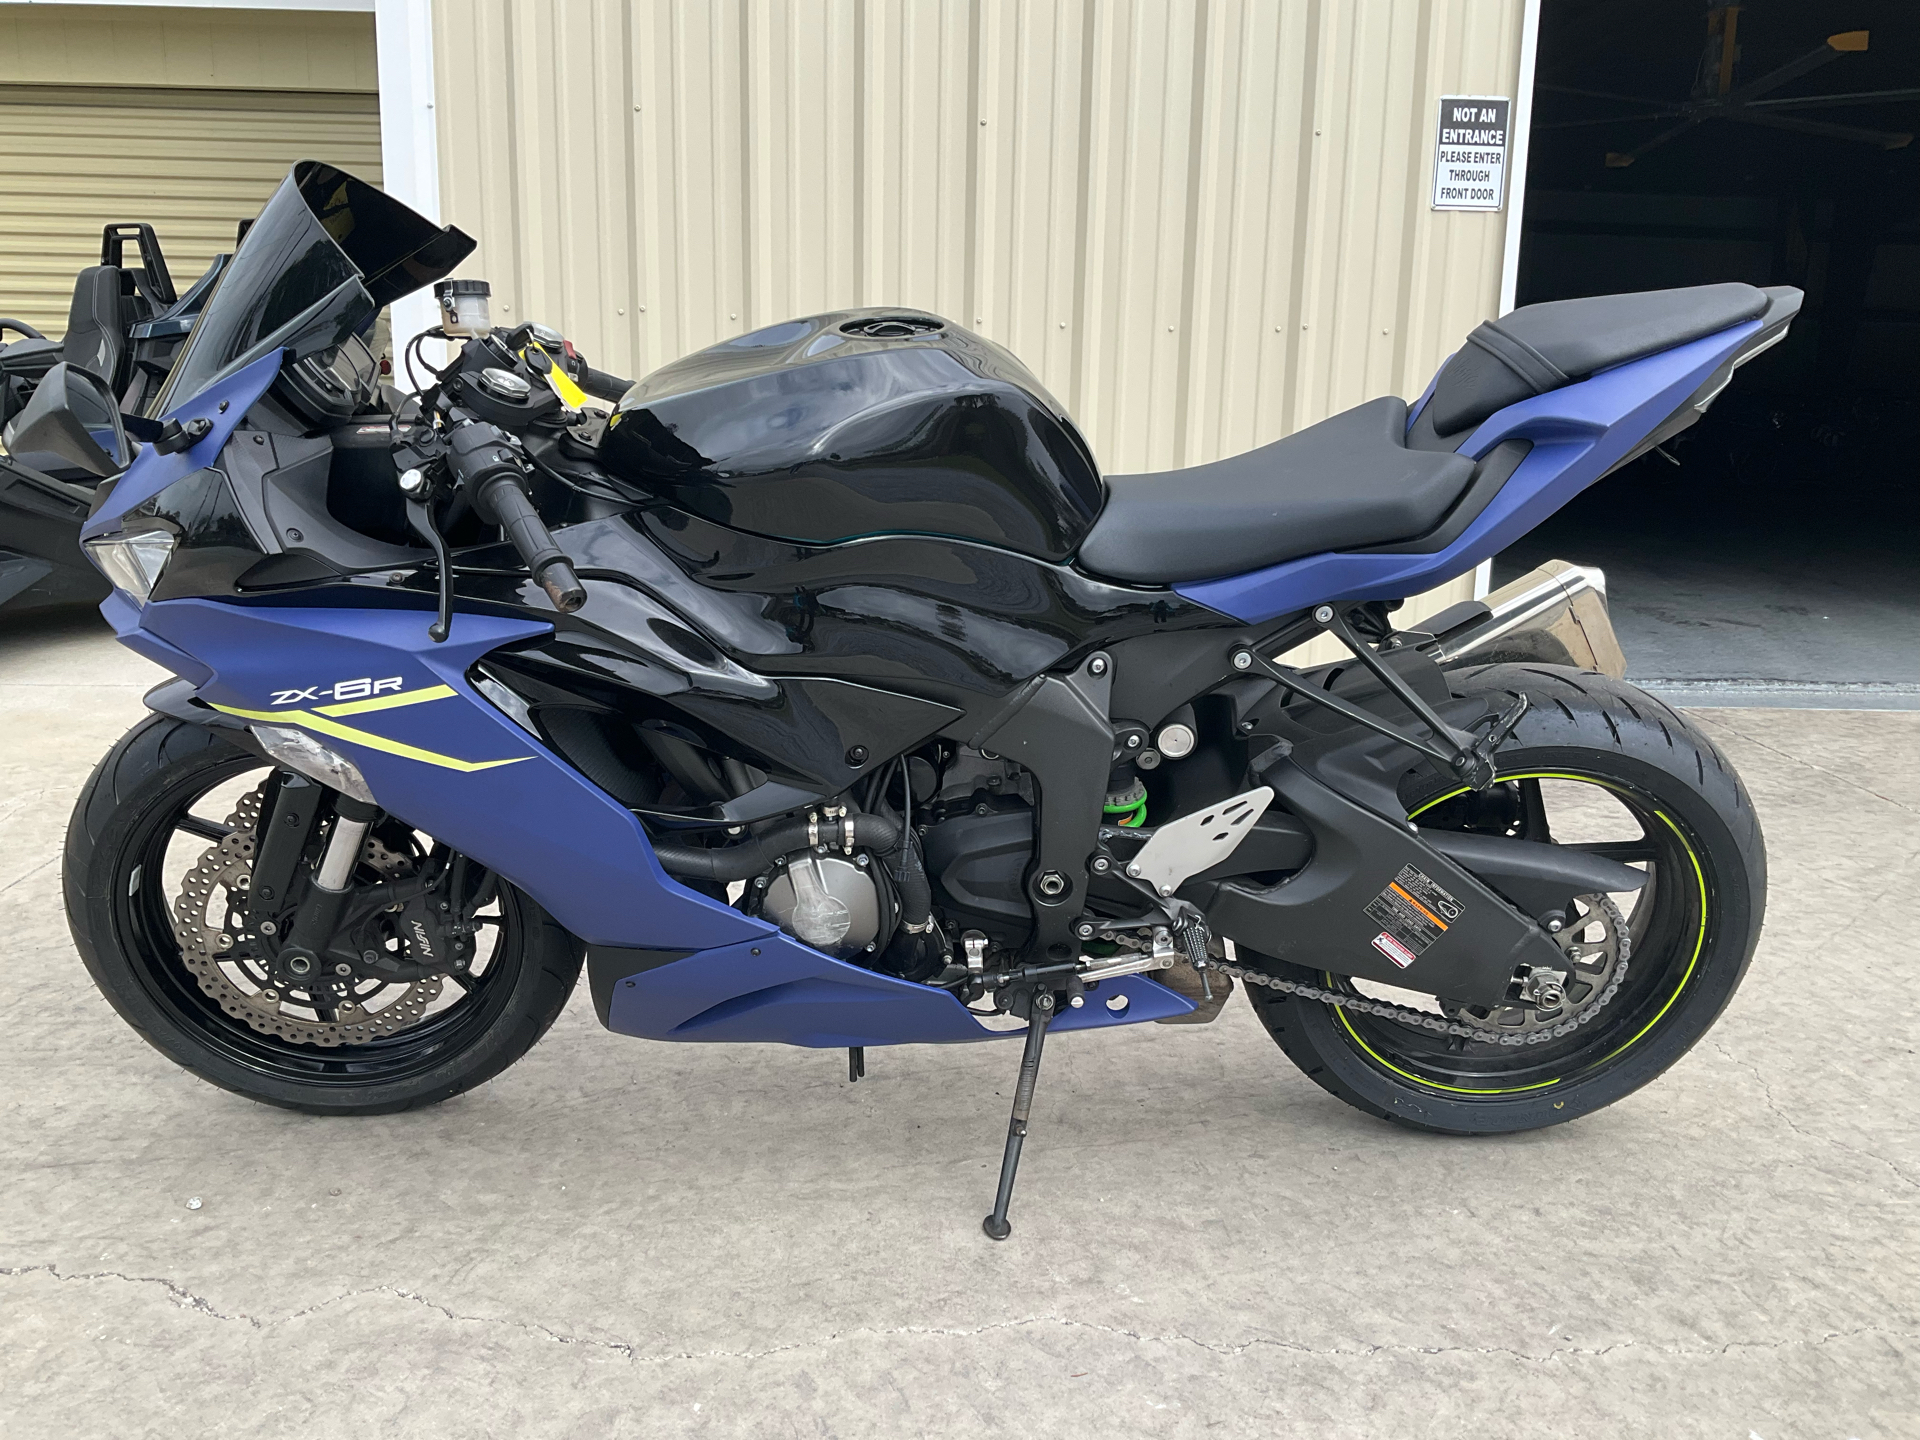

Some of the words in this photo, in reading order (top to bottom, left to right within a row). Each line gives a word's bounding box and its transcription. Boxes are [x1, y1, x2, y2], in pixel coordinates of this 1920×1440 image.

[1453, 107, 1478, 122] NOT
[1479, 108, 1497, 123] AN
[1442, 128, 1504, 145] ENTRANCE
[1440, 150, 1472, 164] PLEASE
[1473, 152, 1501, 165] ENTER
[1449, 169, 1490, 182] THROUGH
[1440, 187, 1469, 200] FRONT
[1470, 188, 1494, 201] DOOR
[269, 675, 403, 706] ZX-6R
[411, 920, 434, 957] NISSIN
